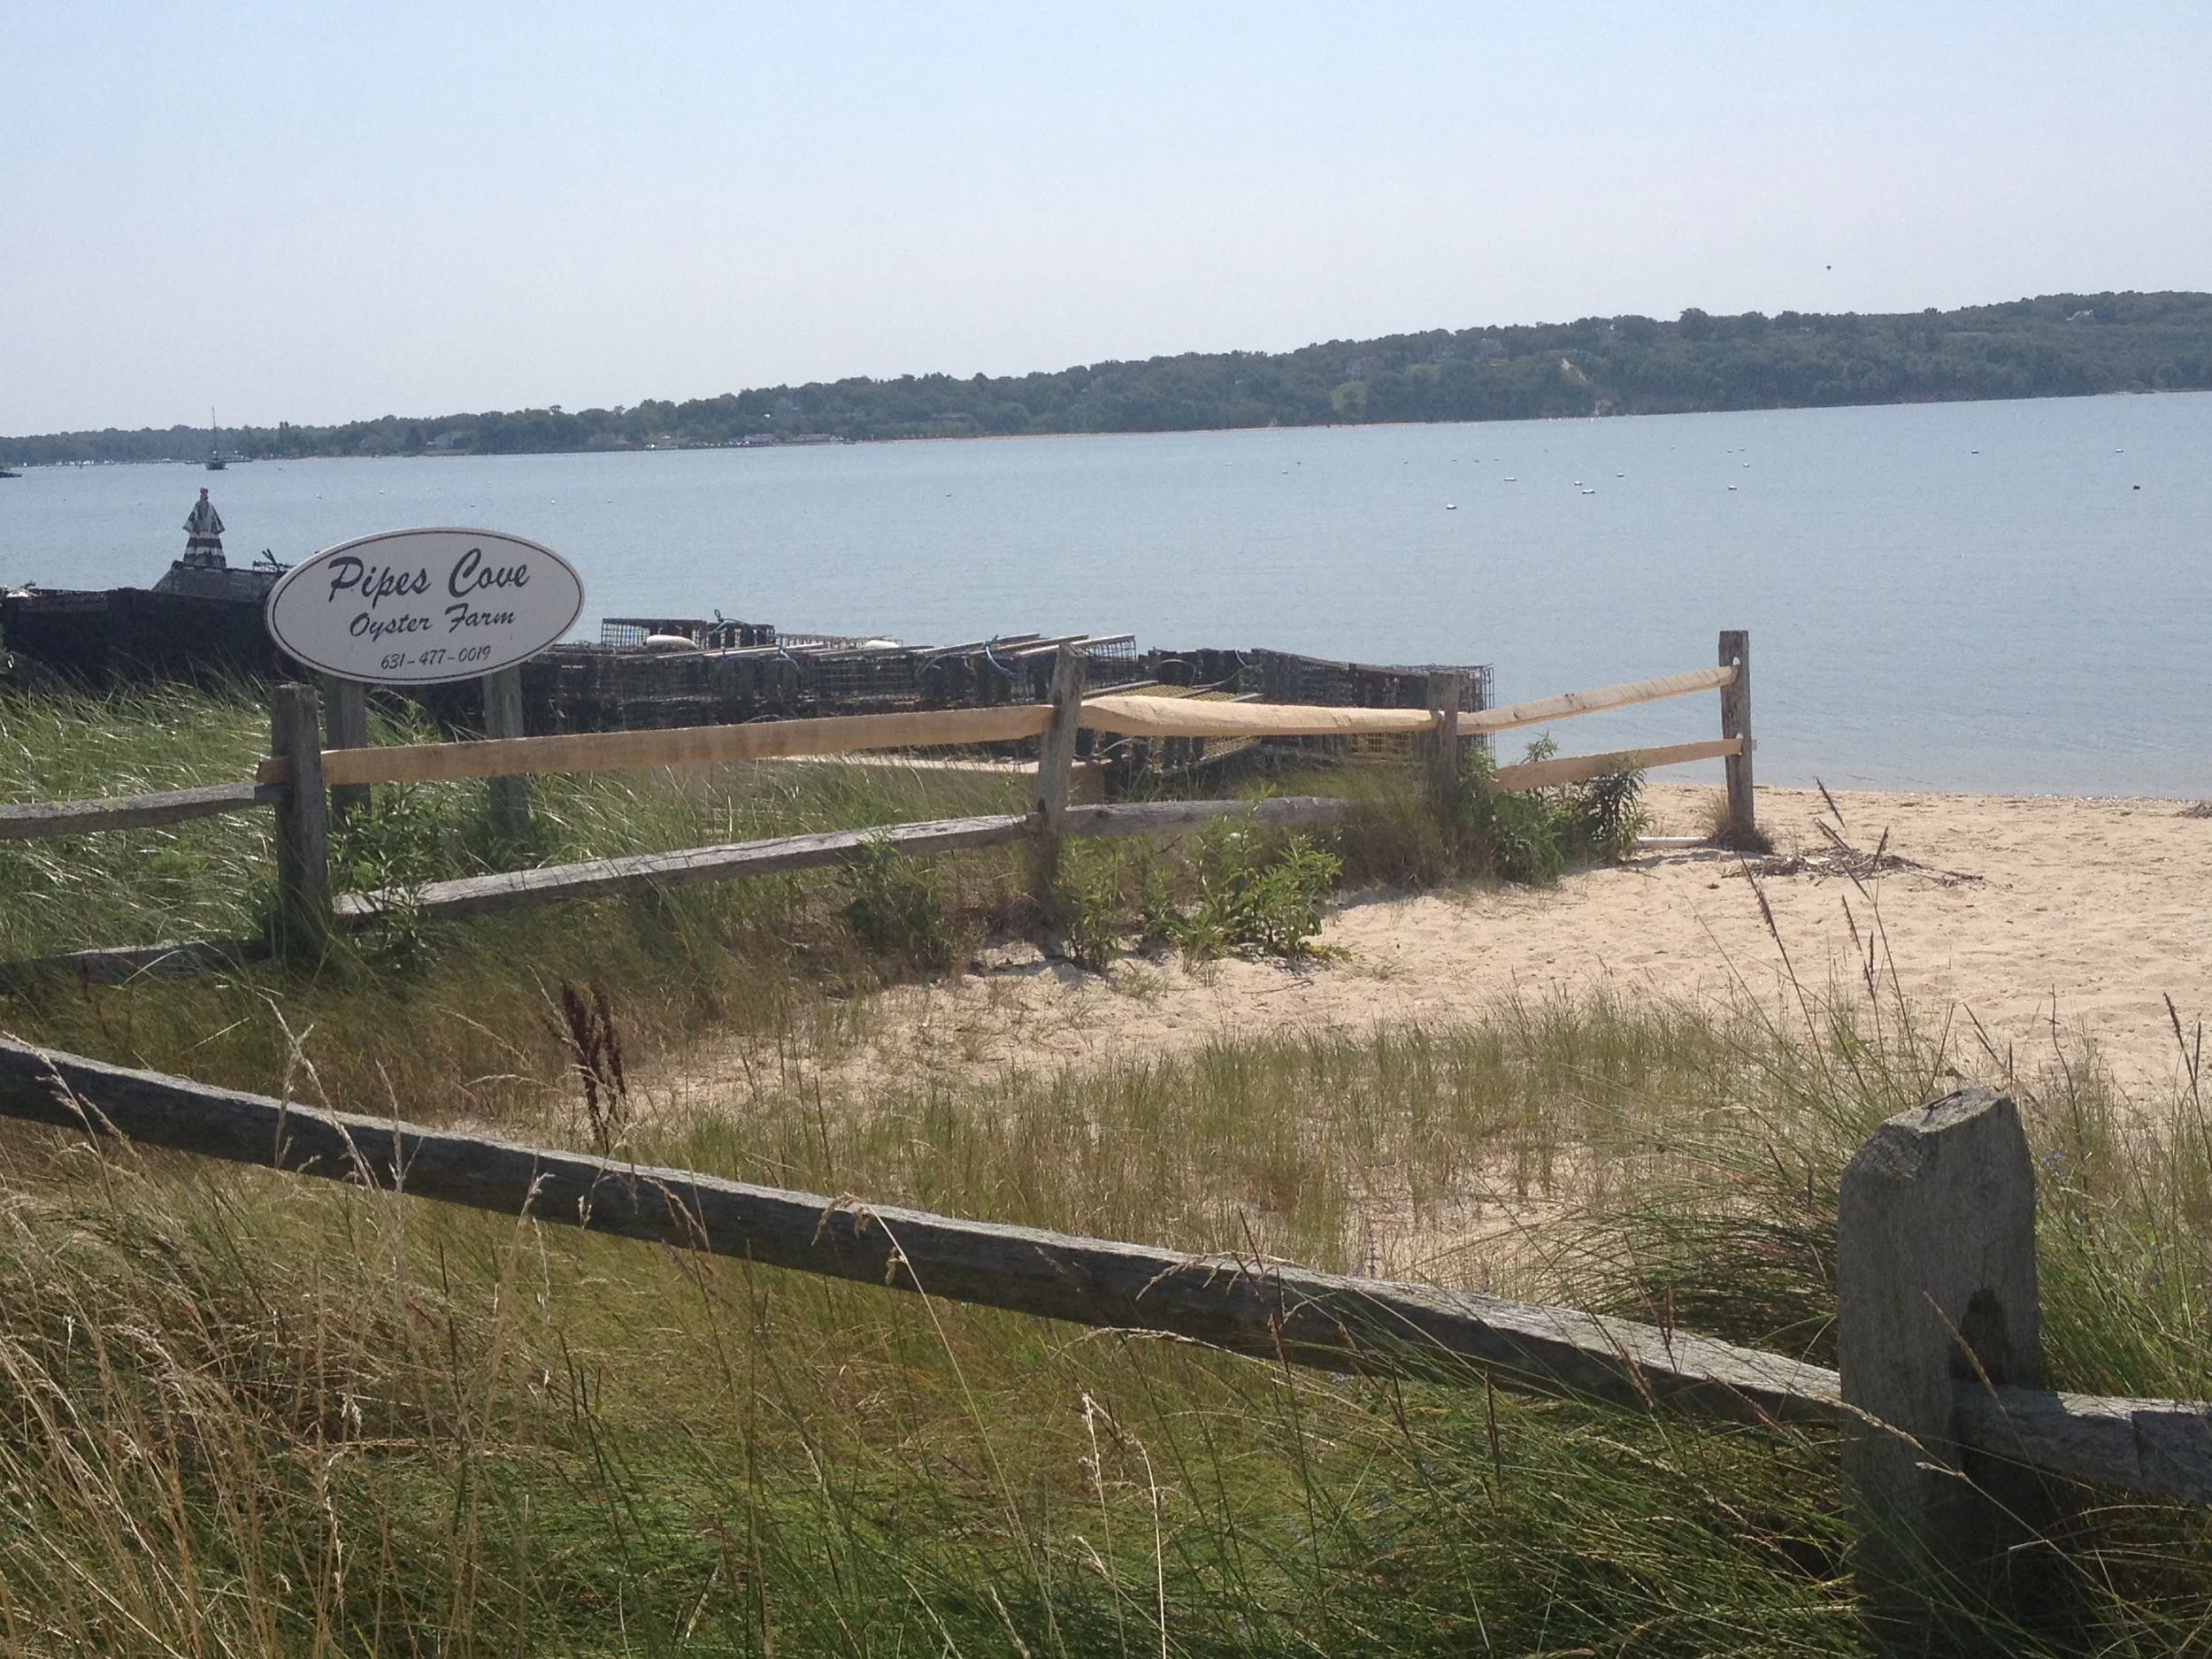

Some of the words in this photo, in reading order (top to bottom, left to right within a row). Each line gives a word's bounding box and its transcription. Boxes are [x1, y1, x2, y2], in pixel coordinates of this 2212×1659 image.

[327, 556, 432, 610] Pipes
[448, 548, 531, 599] Cove
[349, 611, 433, 642] Oyster
[444, 603, 517, 634] Farm
